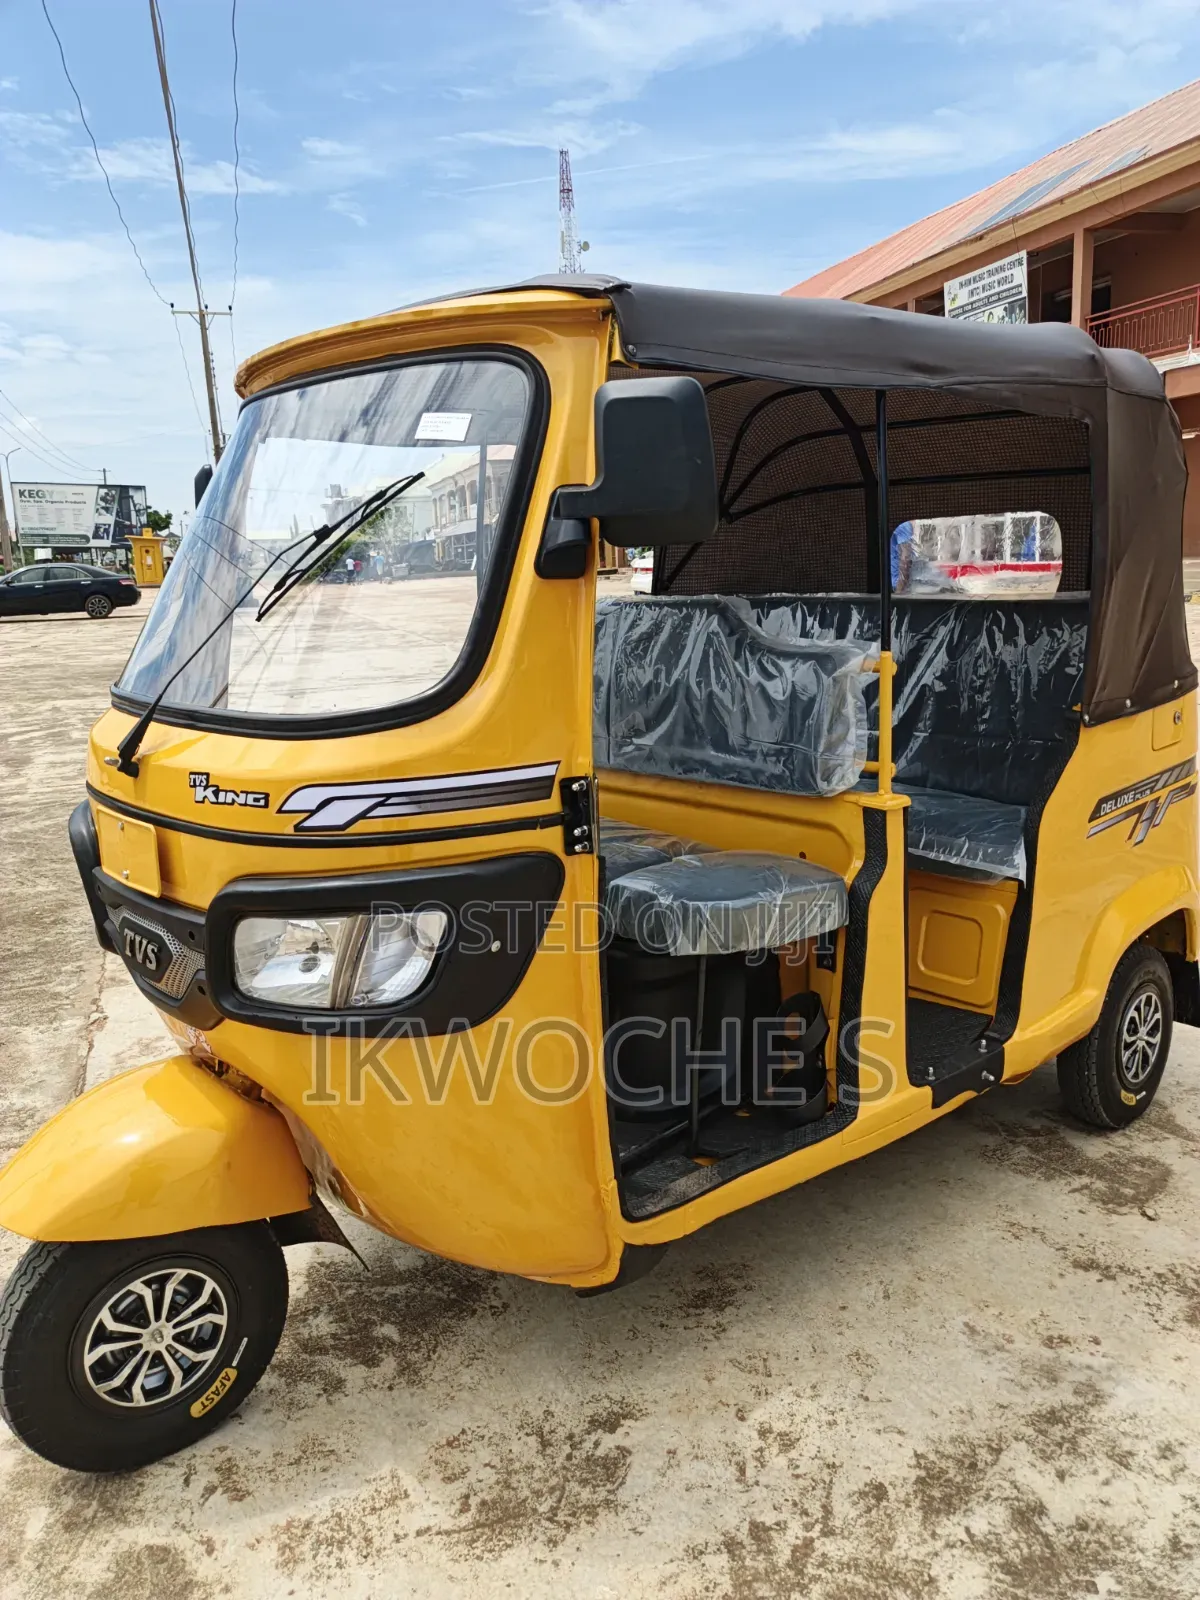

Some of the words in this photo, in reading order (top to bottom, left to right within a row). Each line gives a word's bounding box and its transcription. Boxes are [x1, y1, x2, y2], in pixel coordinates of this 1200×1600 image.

[973, 272, 985, 284] MUSIC
[986, 264, 1006, 279] TRAINING
[1006, 257, 1024, 271] CENTRE
[982, 280, 996, 293] MUSIC
[997, 273, 1014, 287] WORLD
[963, 304, 972, 312] FOR
[989, 295, 999, 303] AND
[1000, 287, 1022, 298] CHILDREN
[189, 774, 208, 787] TVS
[1100, 791, 1136, 816] DELUXE
[1135, 789, 1151, 800] PLUS
[123, 928, 158, 970] TVS
[200, 1371, 231, 1411] AFAST
